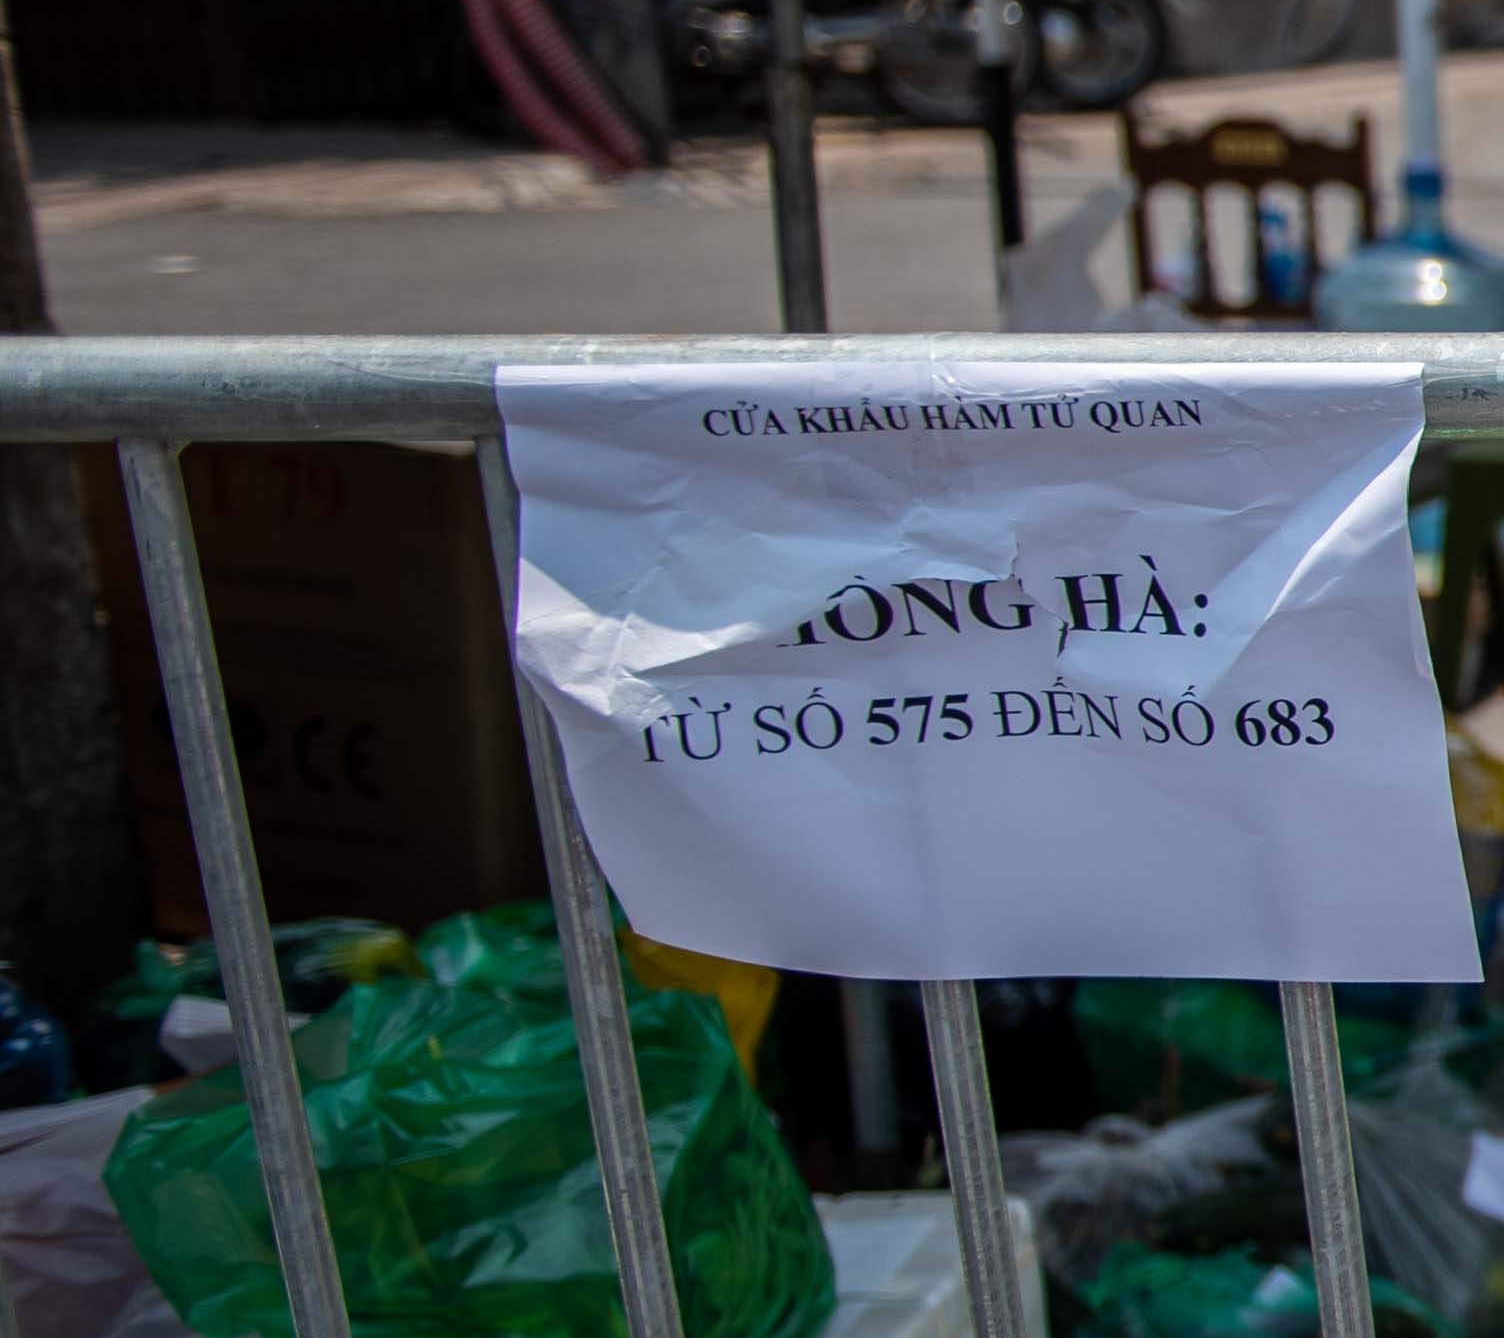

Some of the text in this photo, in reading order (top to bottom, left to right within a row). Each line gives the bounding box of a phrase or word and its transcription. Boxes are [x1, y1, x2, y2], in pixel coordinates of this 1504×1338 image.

[703, 401, 788, 436] CỬA
[920, 394, 1014, 430] HÀM
[1021, 392, 1085, 429] TỬ
[1090, 400, 1201, 433] QUAN
[1055, 555, 1208, 637] HÀ:
[644, 677, 1334, 762] TỪ SỐ 575 ĐẾN SỐ 683
